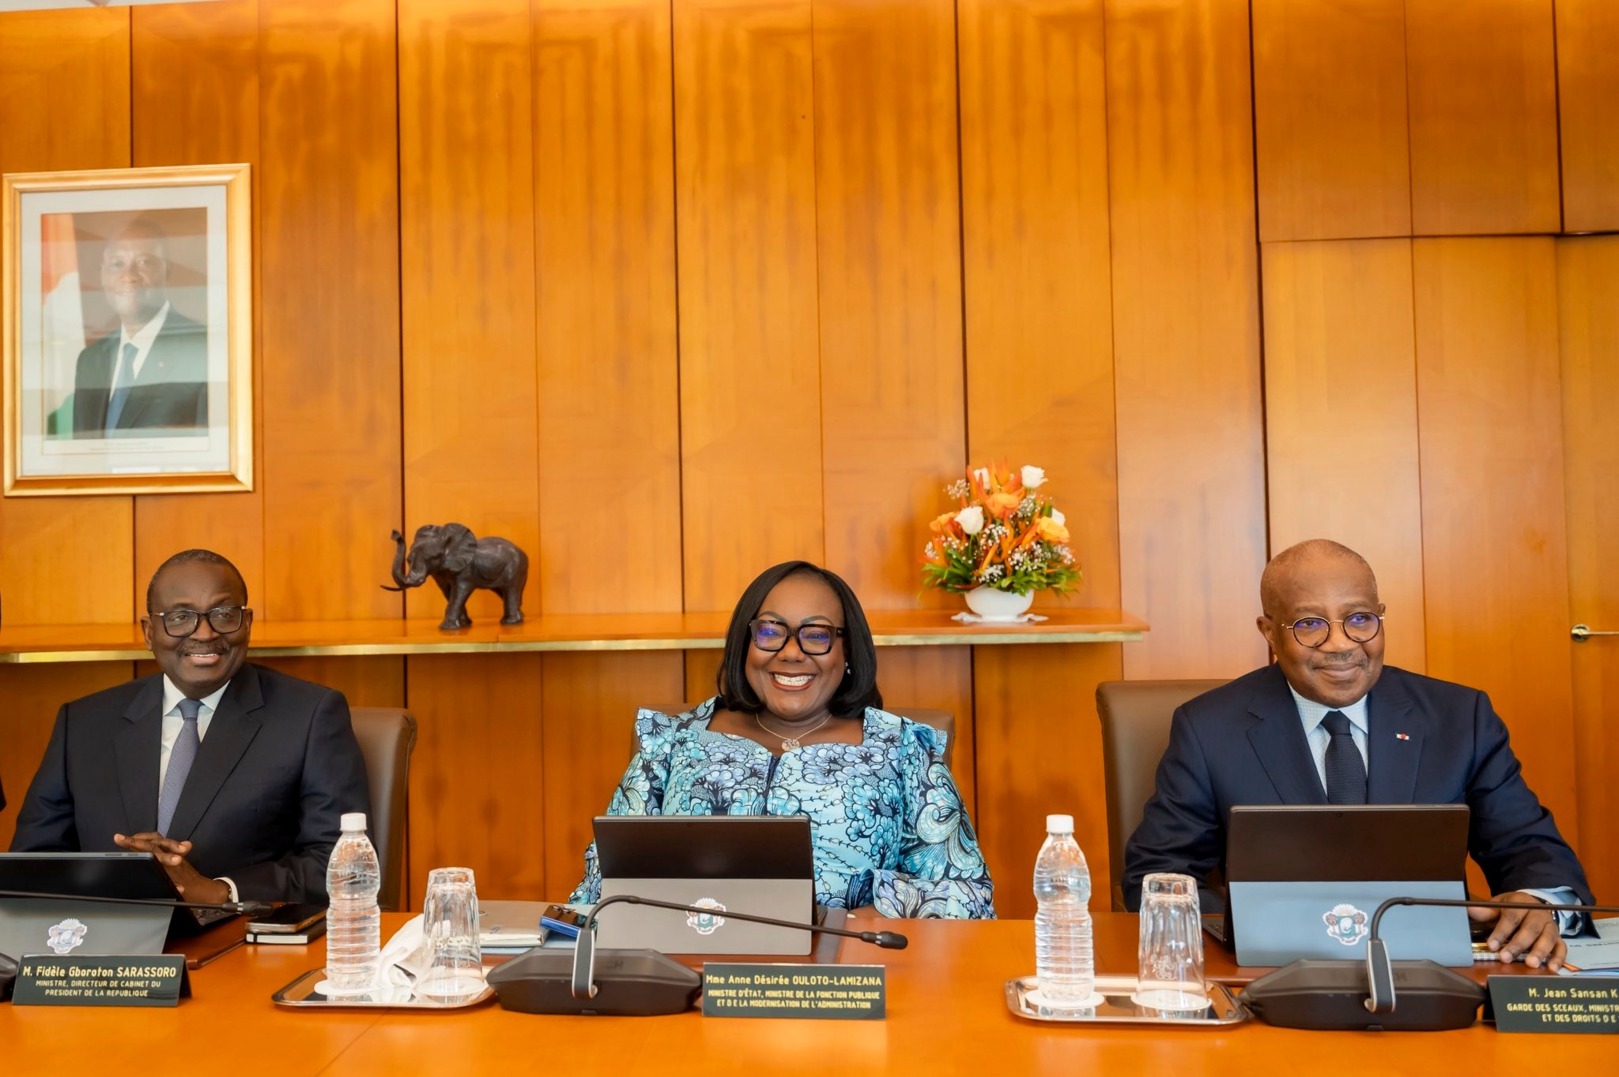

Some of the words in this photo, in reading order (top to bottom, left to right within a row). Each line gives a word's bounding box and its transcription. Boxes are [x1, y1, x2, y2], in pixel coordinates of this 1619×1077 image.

[36, 966, 65, 977] Fidèle
[116, 967, 176, 977] SARASSORO
[36, 980, 68, 988] MINISTRE,
[706, 975, 724, 984] Mme
[728, 975, 751, 984] Anne
[754, 975, 789, 985] Désirée
[793, 976, 882, 986] OULOTO-LAMIZANA
[849, 991, 880, 1000] PUBLIQUE
[1544, 988, 1567, 998] Jean
[1570, 989, 1608, 998] Sansan
[750, 1000, 800, 1008] MODERNISATION
[1507, 1003, 1533, 1011] GARDE
[1553, 1004, 1587, 1013] SCEAUX,
